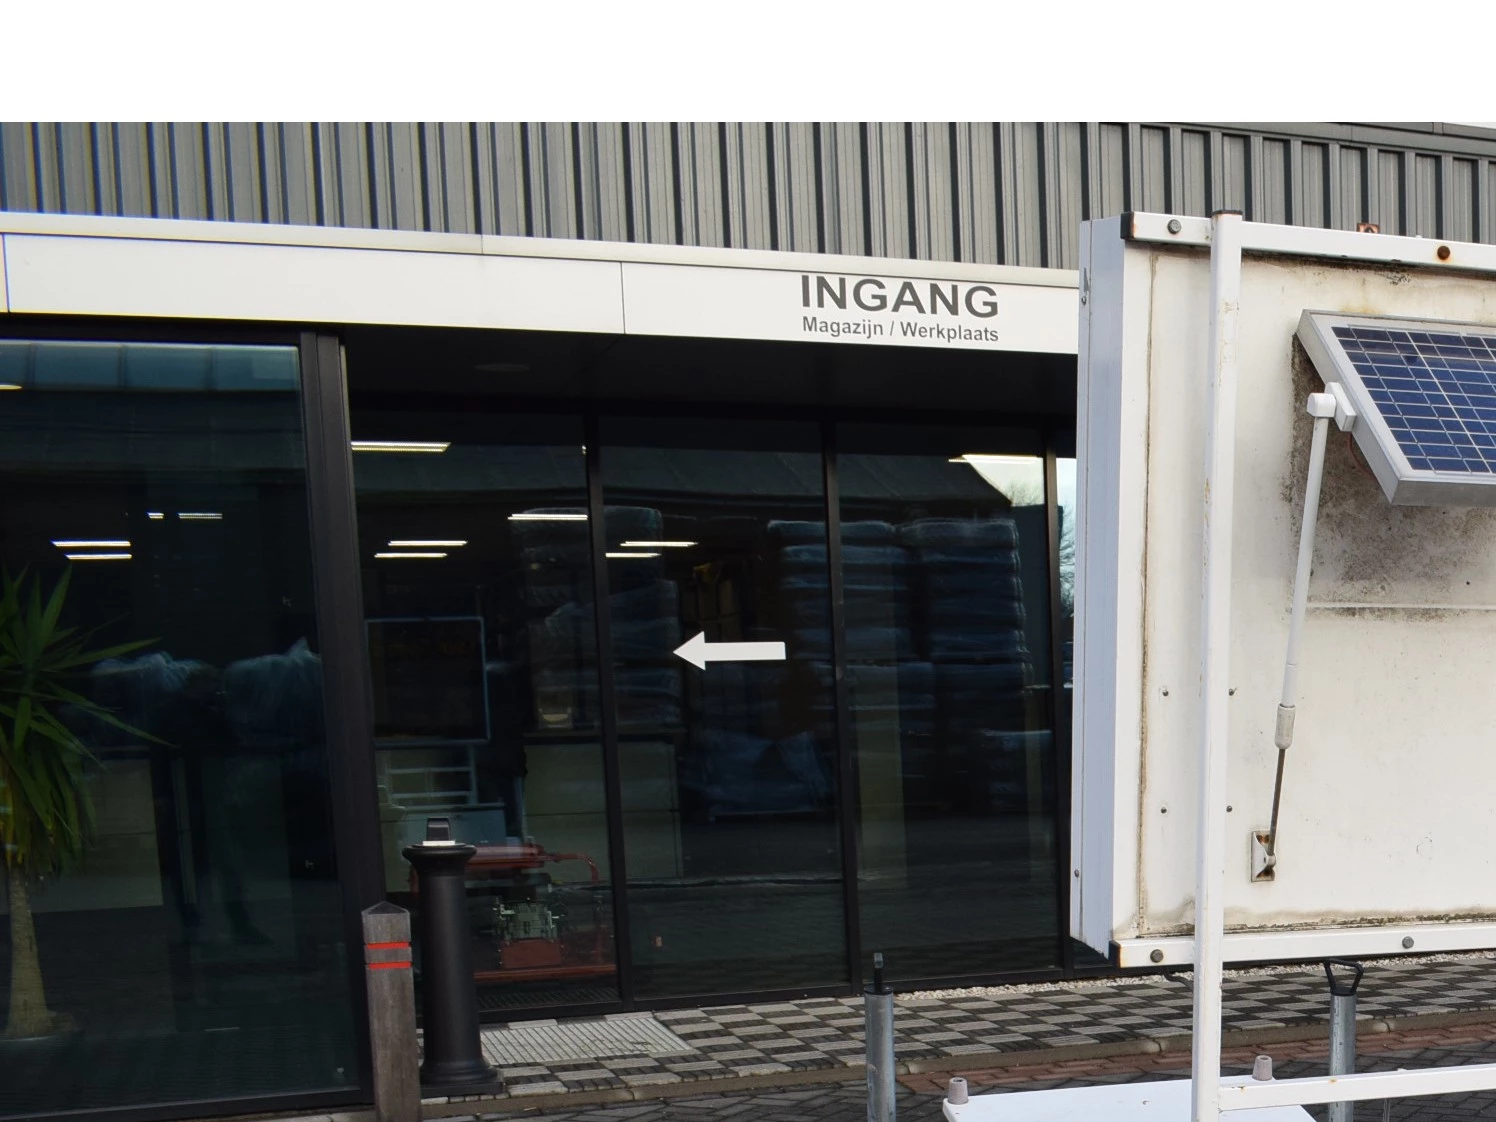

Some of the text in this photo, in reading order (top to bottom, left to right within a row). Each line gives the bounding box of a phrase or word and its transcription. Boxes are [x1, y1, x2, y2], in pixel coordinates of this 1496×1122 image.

[801, 274, 998, 318] INGANG
[802, 316, 884, 339] Magazijn
[900, 321, 999, 343] Werkplaats
